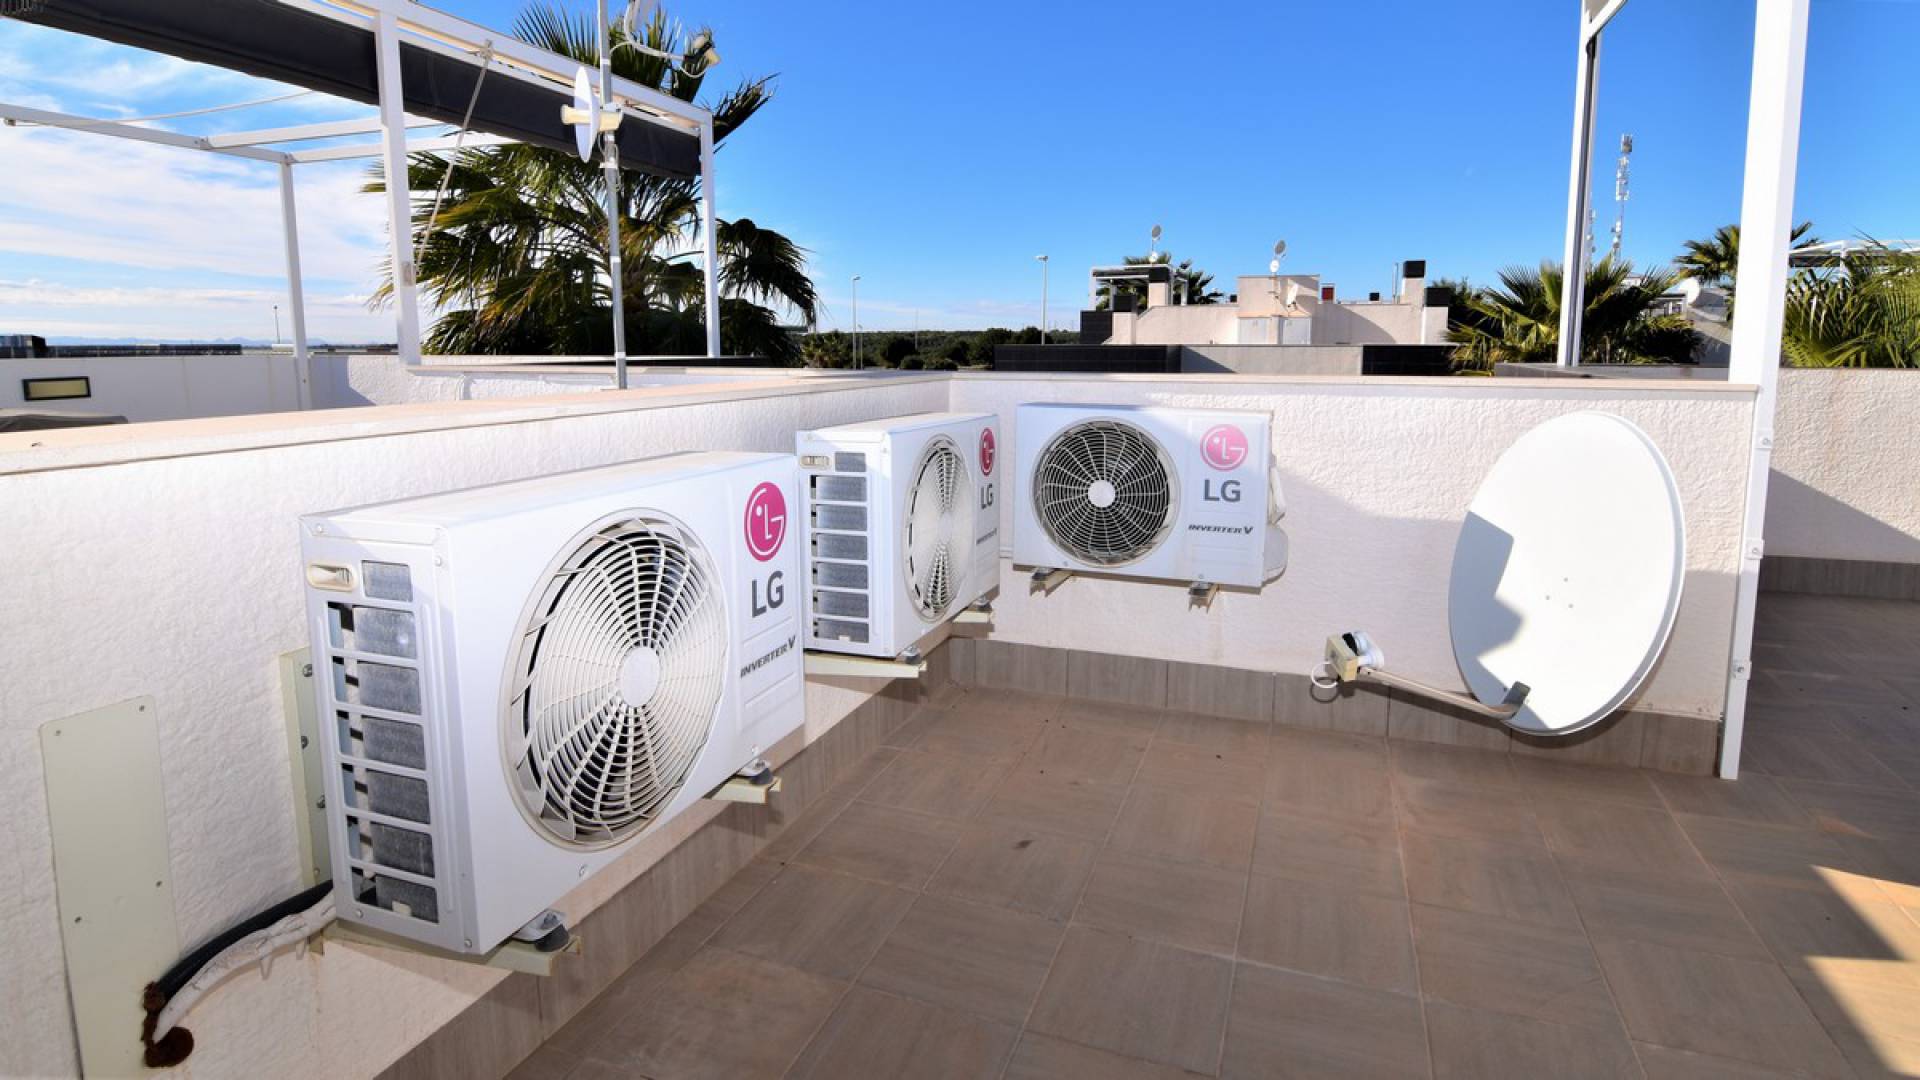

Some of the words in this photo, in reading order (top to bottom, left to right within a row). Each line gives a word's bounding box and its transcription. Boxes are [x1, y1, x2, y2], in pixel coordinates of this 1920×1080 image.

[980, 483, 993, 510] LG
[1203, 479, 1241, 503] LG
[1188, 524, 1242, 534] INVERTER
[751, 570, 785, 618] LG
[740, 643, 788, 678] INVERTER
